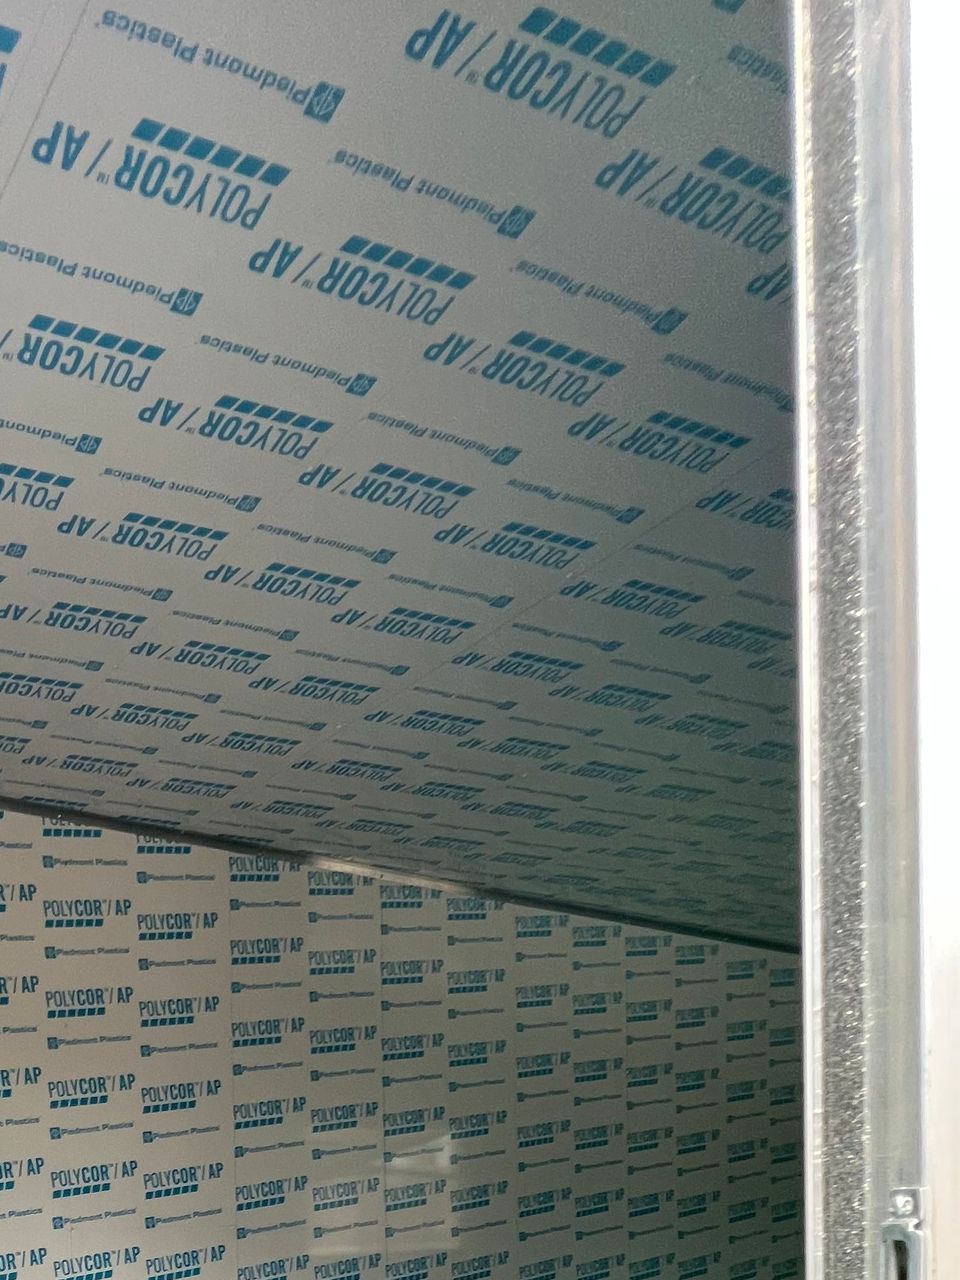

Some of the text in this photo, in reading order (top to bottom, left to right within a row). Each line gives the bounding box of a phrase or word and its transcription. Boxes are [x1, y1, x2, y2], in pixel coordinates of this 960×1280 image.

[405, 9, 477, 67] AP
[100, 12, 311, 105] Piedmont Plastics
[30, 122, 92, 172] AP
[411, 179, 507, 225] Piedmont
[247, 237, 305, 278] AP
[79, 265, 174, 304] Piedmont
[269, 354, 352, 386] Piedmont
[136, 396, 185, 426] AP
[296, 463, 343, 488] AP
[21, 975, 39, 993] AP
[121, 1159, 137, 1178] AP
[63, 1212, 103, 1224] Piedmont
[368, 1252, 381, 1269] AP
